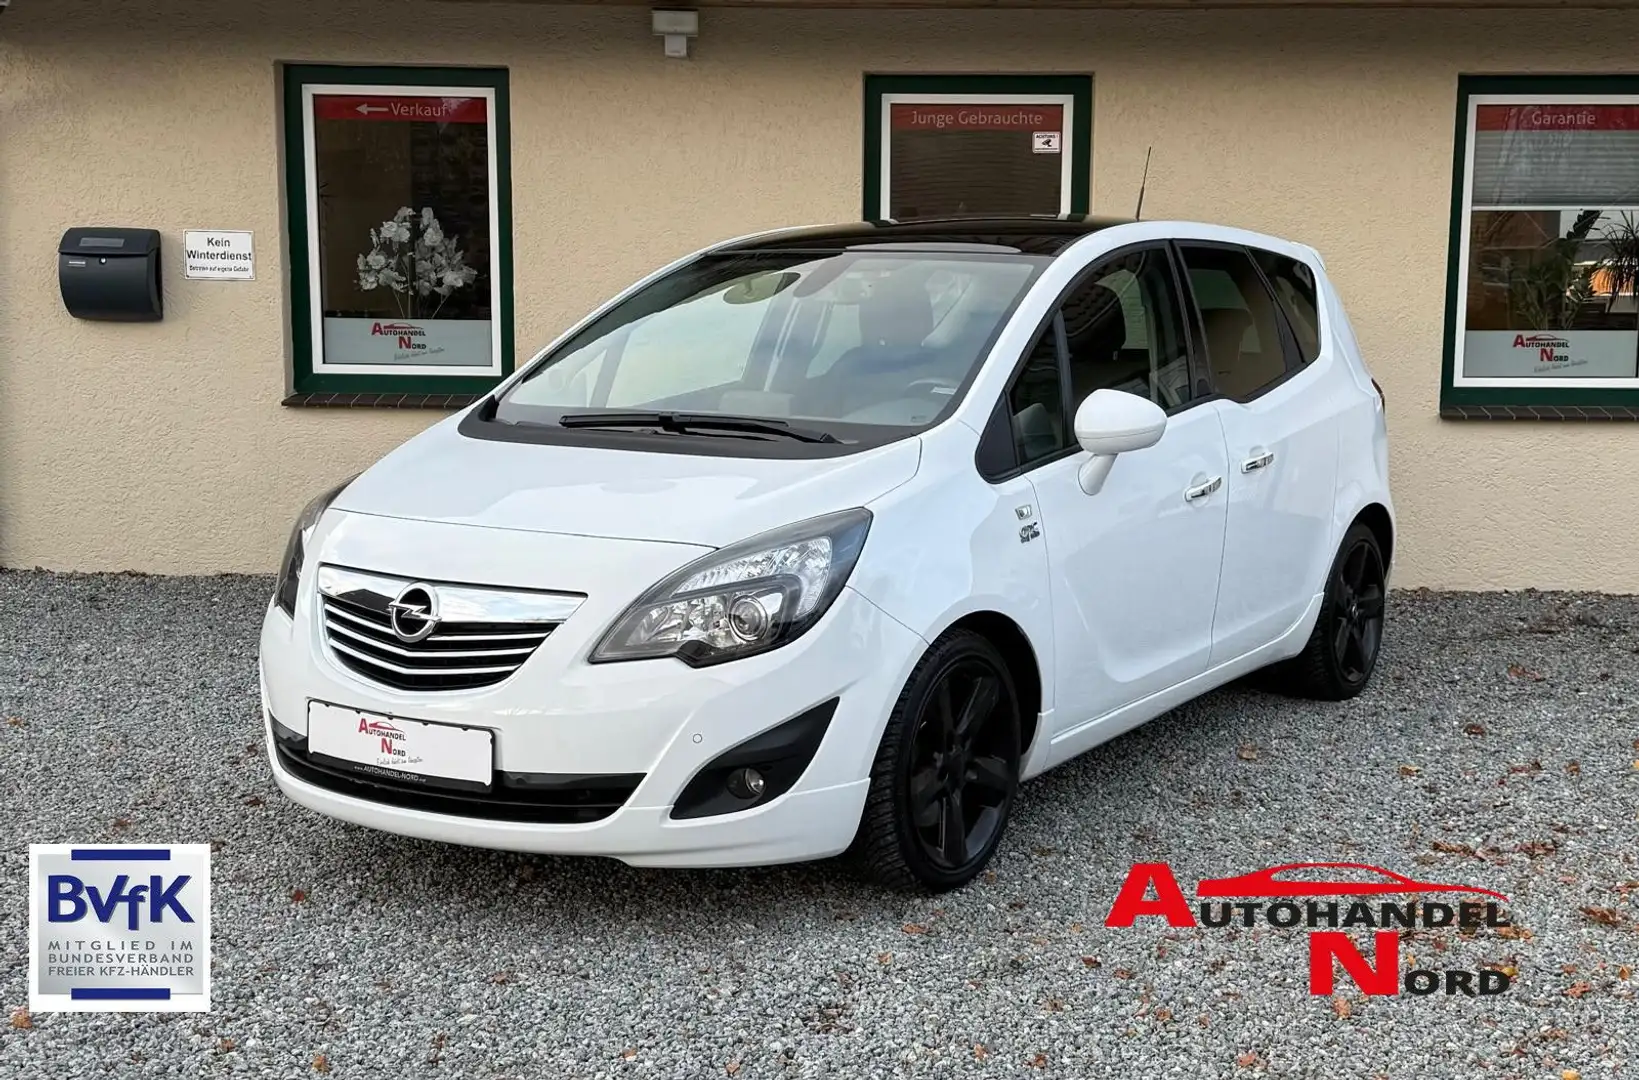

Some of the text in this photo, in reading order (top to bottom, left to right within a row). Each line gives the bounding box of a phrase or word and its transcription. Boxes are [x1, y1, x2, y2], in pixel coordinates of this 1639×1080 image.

[390, 102, 448, 117] Verkauf
[911, 110, 1043, 128] Junge Gebrauchte
[1531, 110, 1596, 125] Garantie
[206, 237, 231, 247] Kein
[186, 249, 252, 261] Winterdienst
[371, 321, 427, 337] AUTOHANDEL
[398, 336, 427, 350] NORD
[1512, 334, 1570, 348] AUTOHANDEL
[1540, 348, 1569, 362] NORD
[358, 717, 406, 741] AUTOHANDEL
[381, 737, 406, 757] NORD
